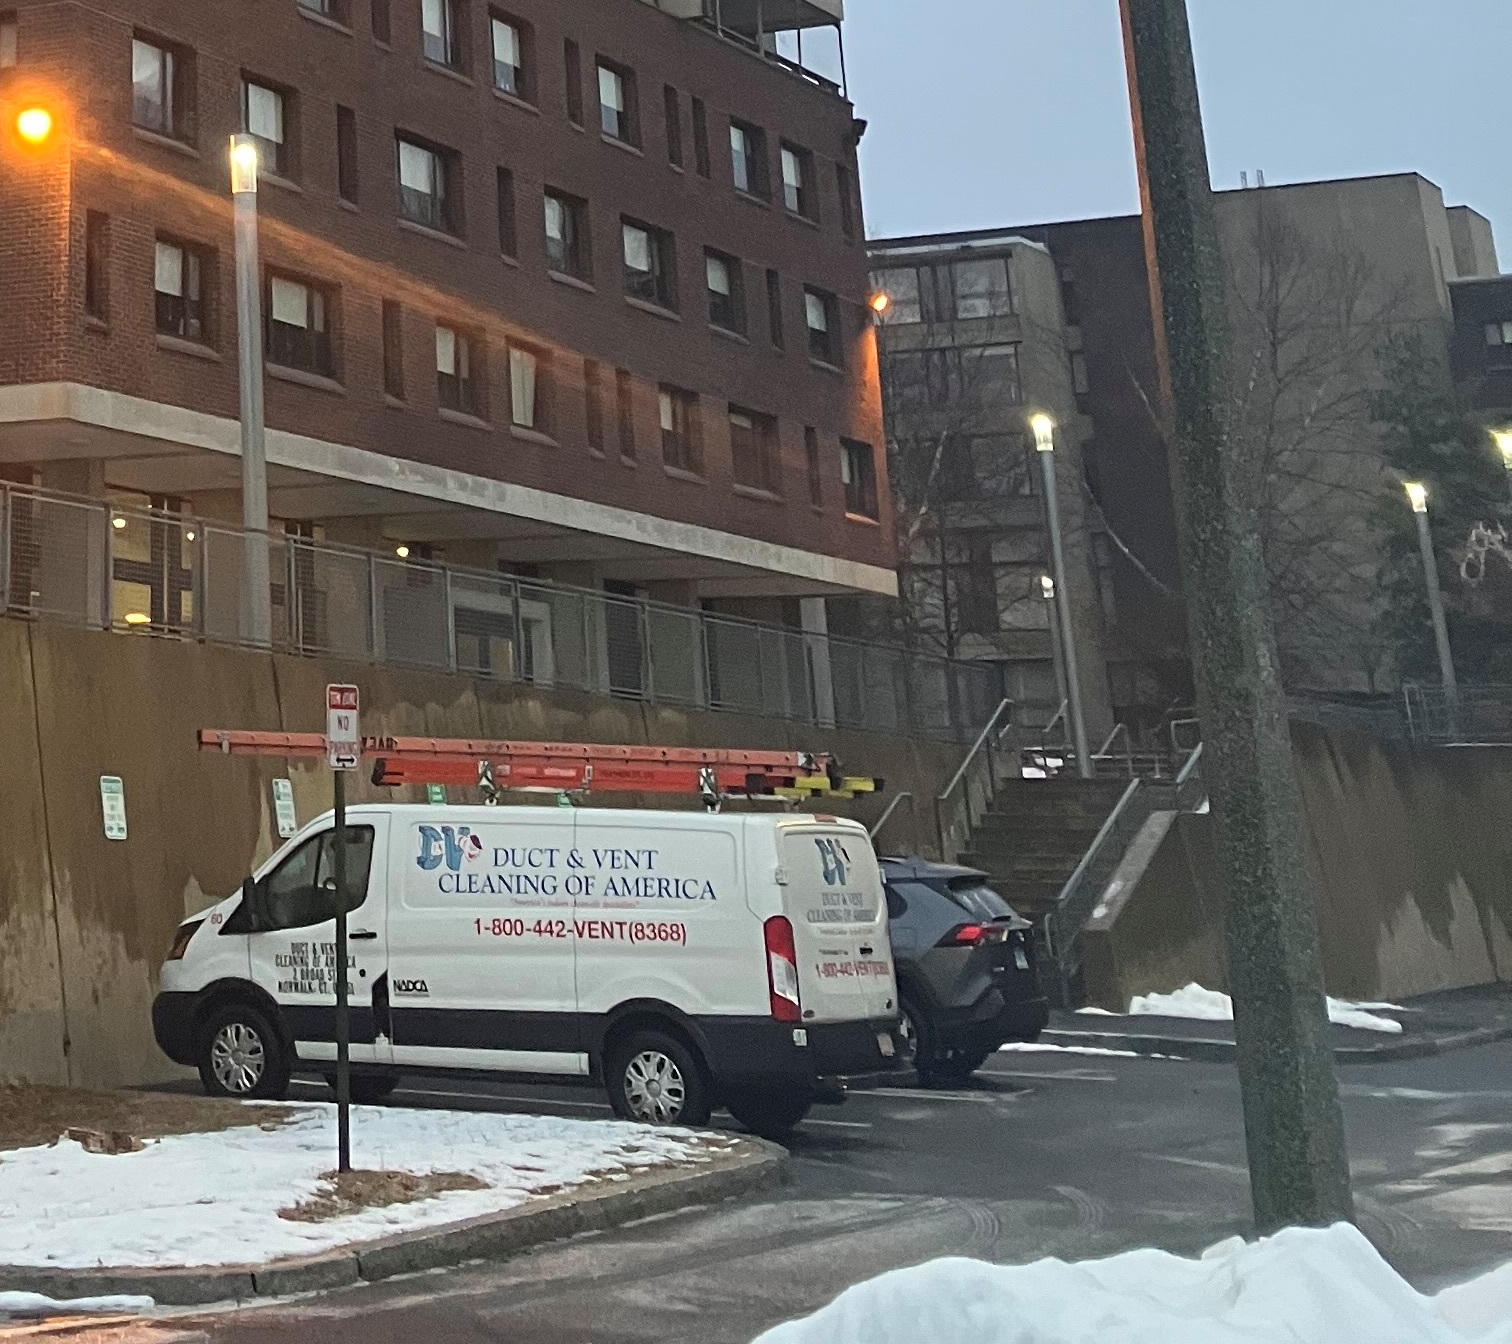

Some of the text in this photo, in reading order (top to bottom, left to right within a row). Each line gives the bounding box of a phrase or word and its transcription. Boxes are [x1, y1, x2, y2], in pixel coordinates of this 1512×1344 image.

[337, 714, 349, 731] NO
[493, 848, 659, 870] DUCT & VENT
[438, 873, 717, 900] CLEANING OF AMERICA
[211, 913, 223, 925] 60
[473, 918, 686, 946] 1-800-442-VENT(8368)
[393, 979, 429, 993] NADCA
